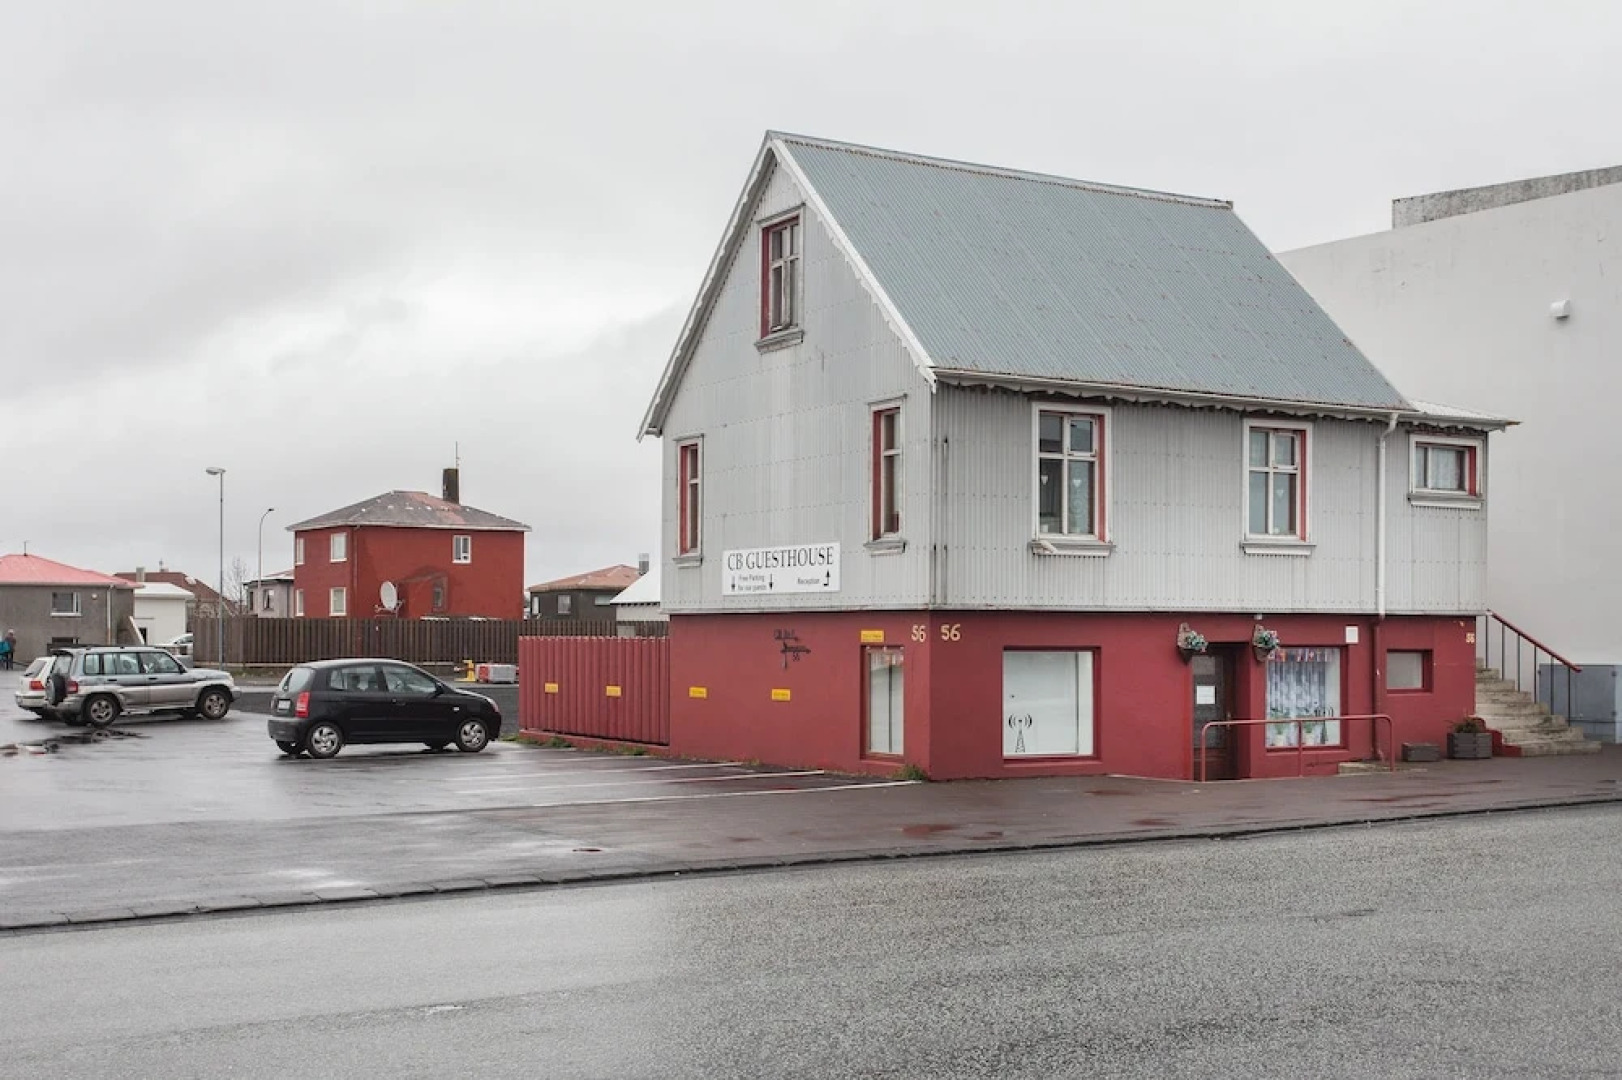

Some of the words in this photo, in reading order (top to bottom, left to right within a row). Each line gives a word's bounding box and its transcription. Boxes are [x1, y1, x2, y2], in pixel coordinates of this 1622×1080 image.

[727, 552, 744, 571] CB
[745, 546, 834, 570] GUESTHOUSE
[797, 577, 820, 585] Reception
[911, 625, 926, 642] 56
[941, 624, 961, 641] 56
